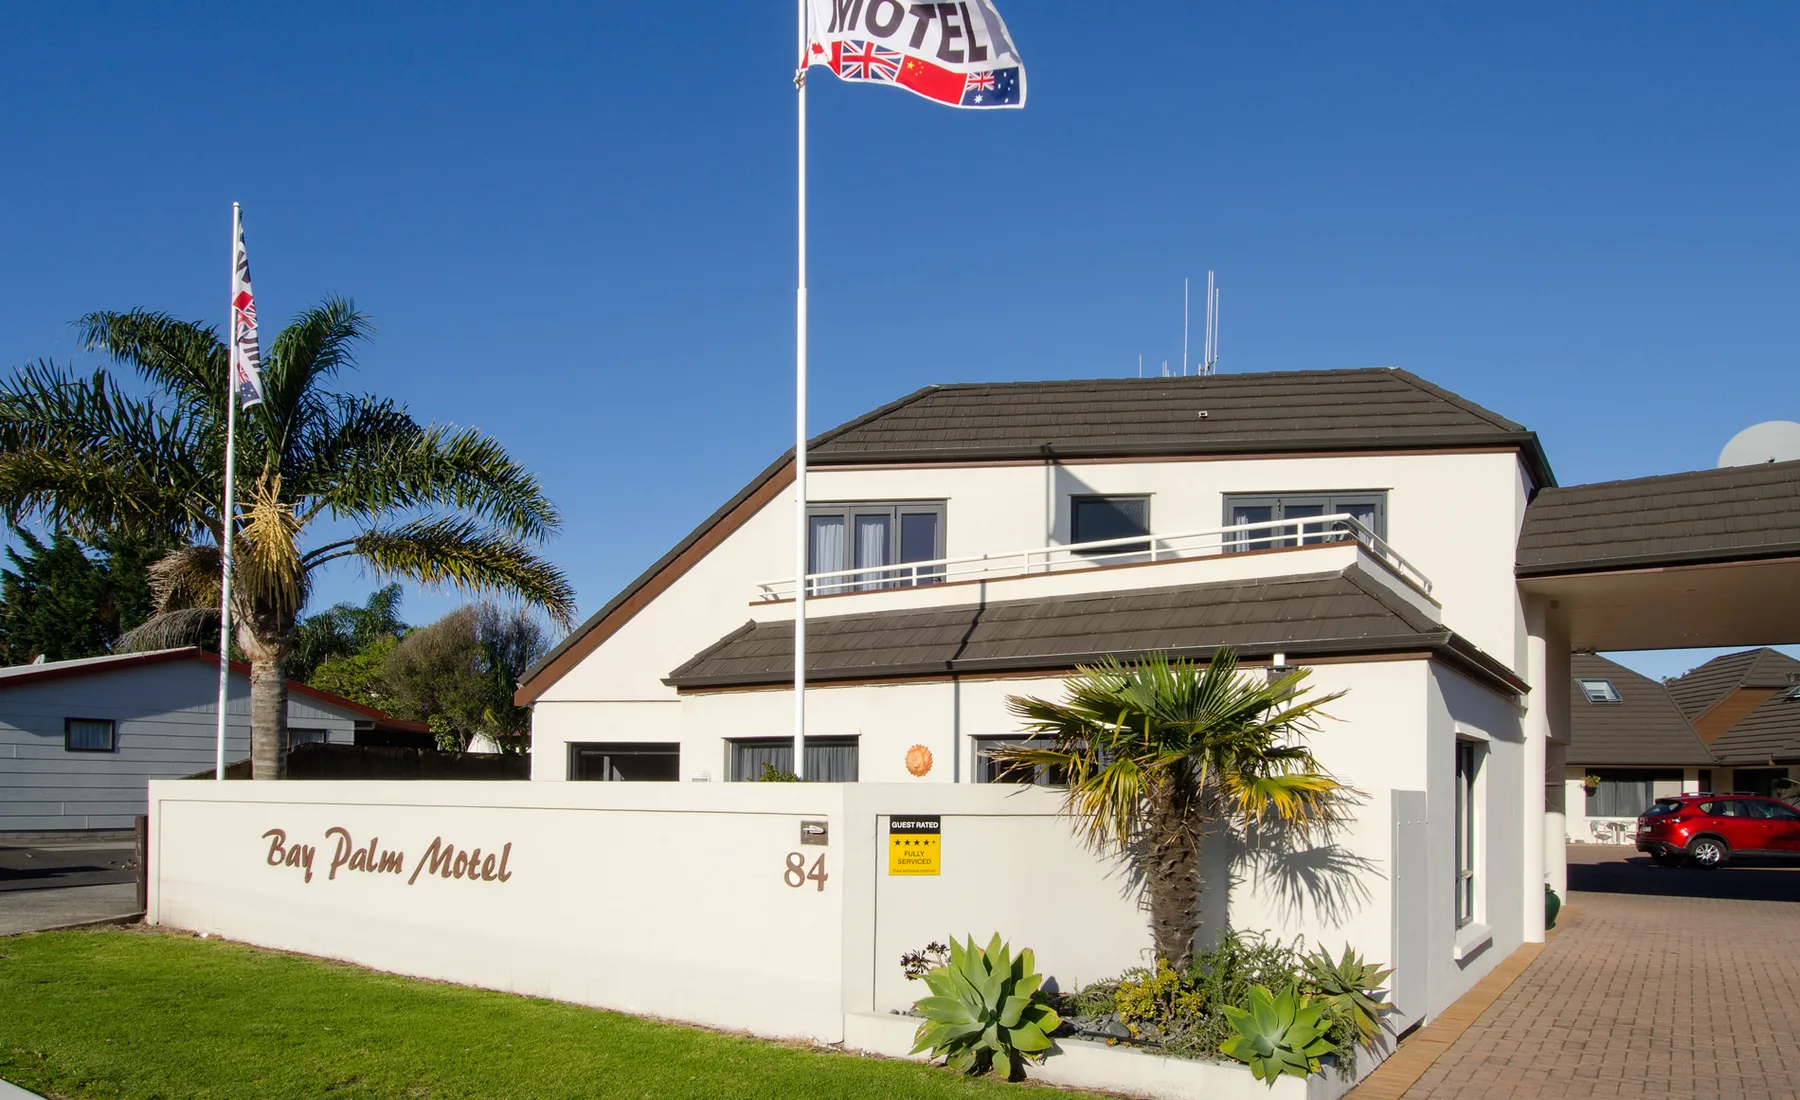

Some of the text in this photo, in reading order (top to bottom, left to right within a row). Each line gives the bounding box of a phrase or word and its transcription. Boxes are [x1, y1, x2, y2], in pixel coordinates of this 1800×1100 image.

[828, 0, 987, 64] MOTEL
[262, 827, 512, 885] Bay Palm Motel
[784, 852, 828, 892] 84
